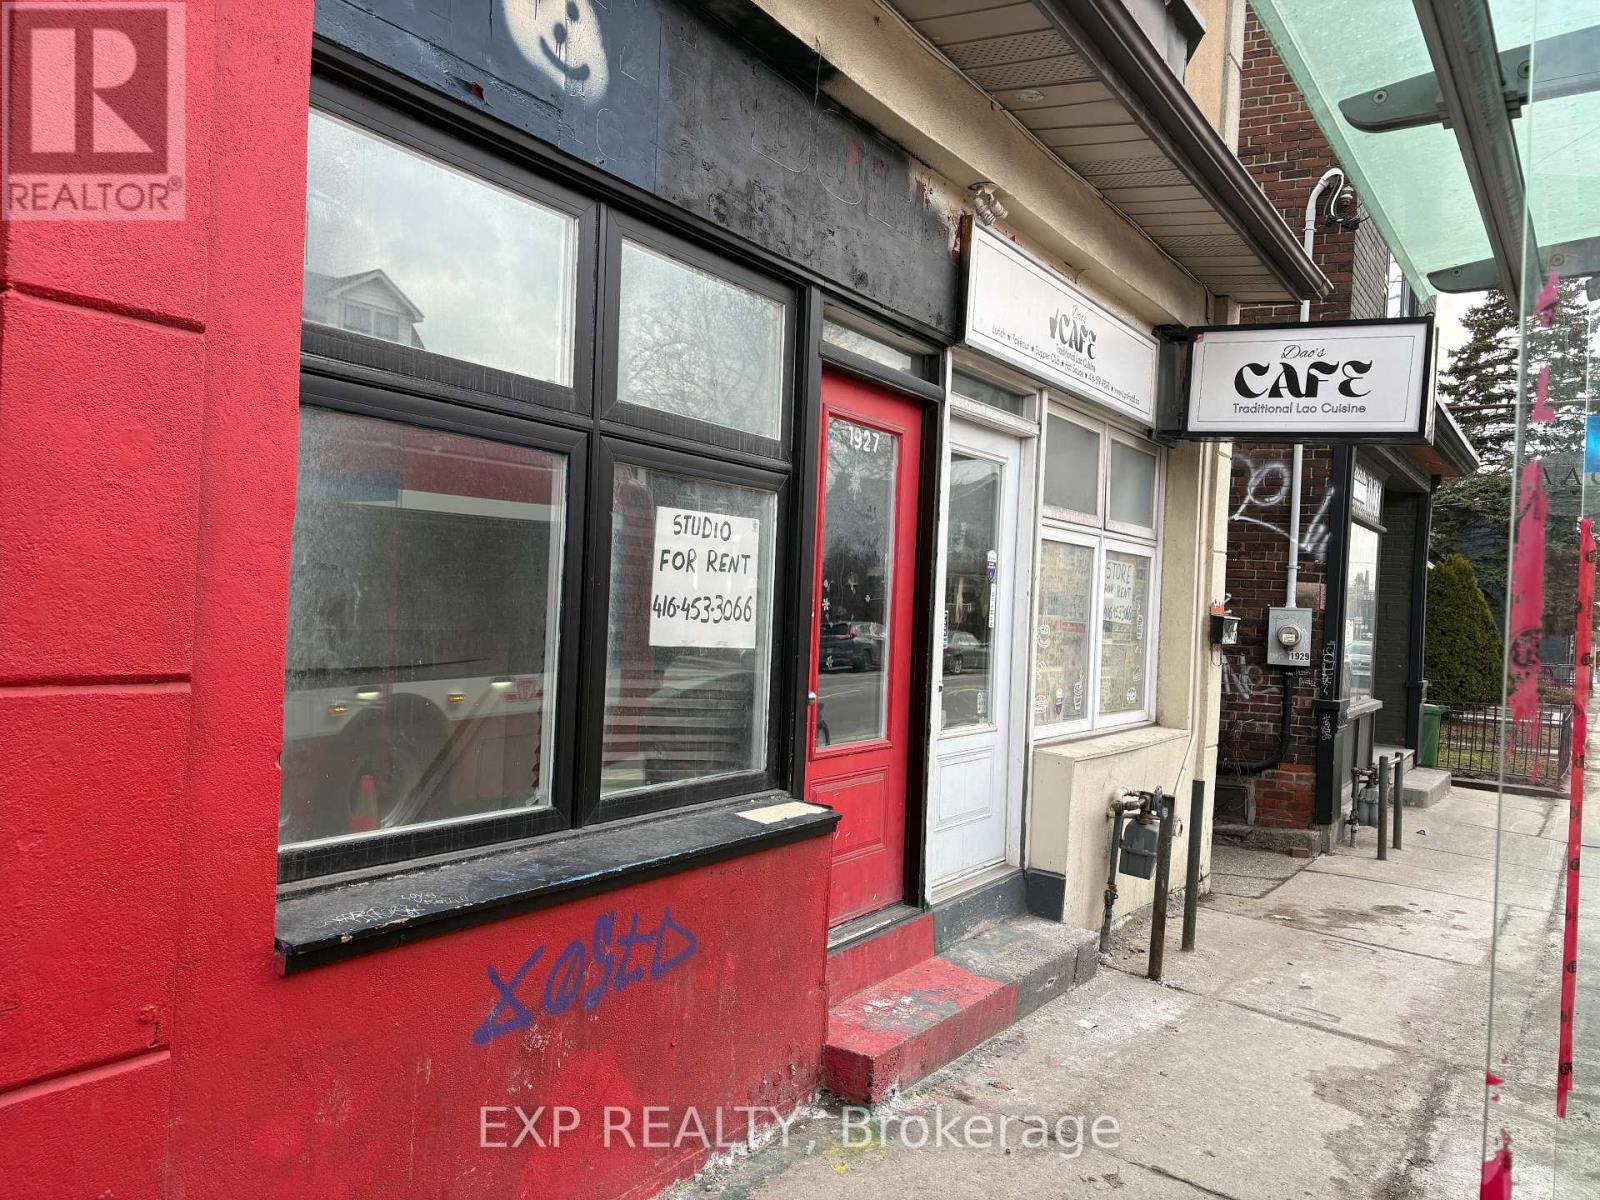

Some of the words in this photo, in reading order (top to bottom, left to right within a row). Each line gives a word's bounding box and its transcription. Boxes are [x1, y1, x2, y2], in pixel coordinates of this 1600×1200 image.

[1058, 313, 1097, 360] CAFE
[1280, 344, 1327, 360] Dao's
[1234, 359, 1373, 399] CAFE
[1232, 402, 1293, 414] Traditional
[1296, 402, 1318, 414] Lao
[1321, 402, 1367, 414] Cuisine
[849, 426, 880, 453] 1927
[673, 514, 732, 542] STUDIO
[659, 548, 698, 574] FOR
[706, 549, 751, 575] RENT
[1105, 561, 1132, 584] STORE
[1290, 651, 1310, 661] 1929
